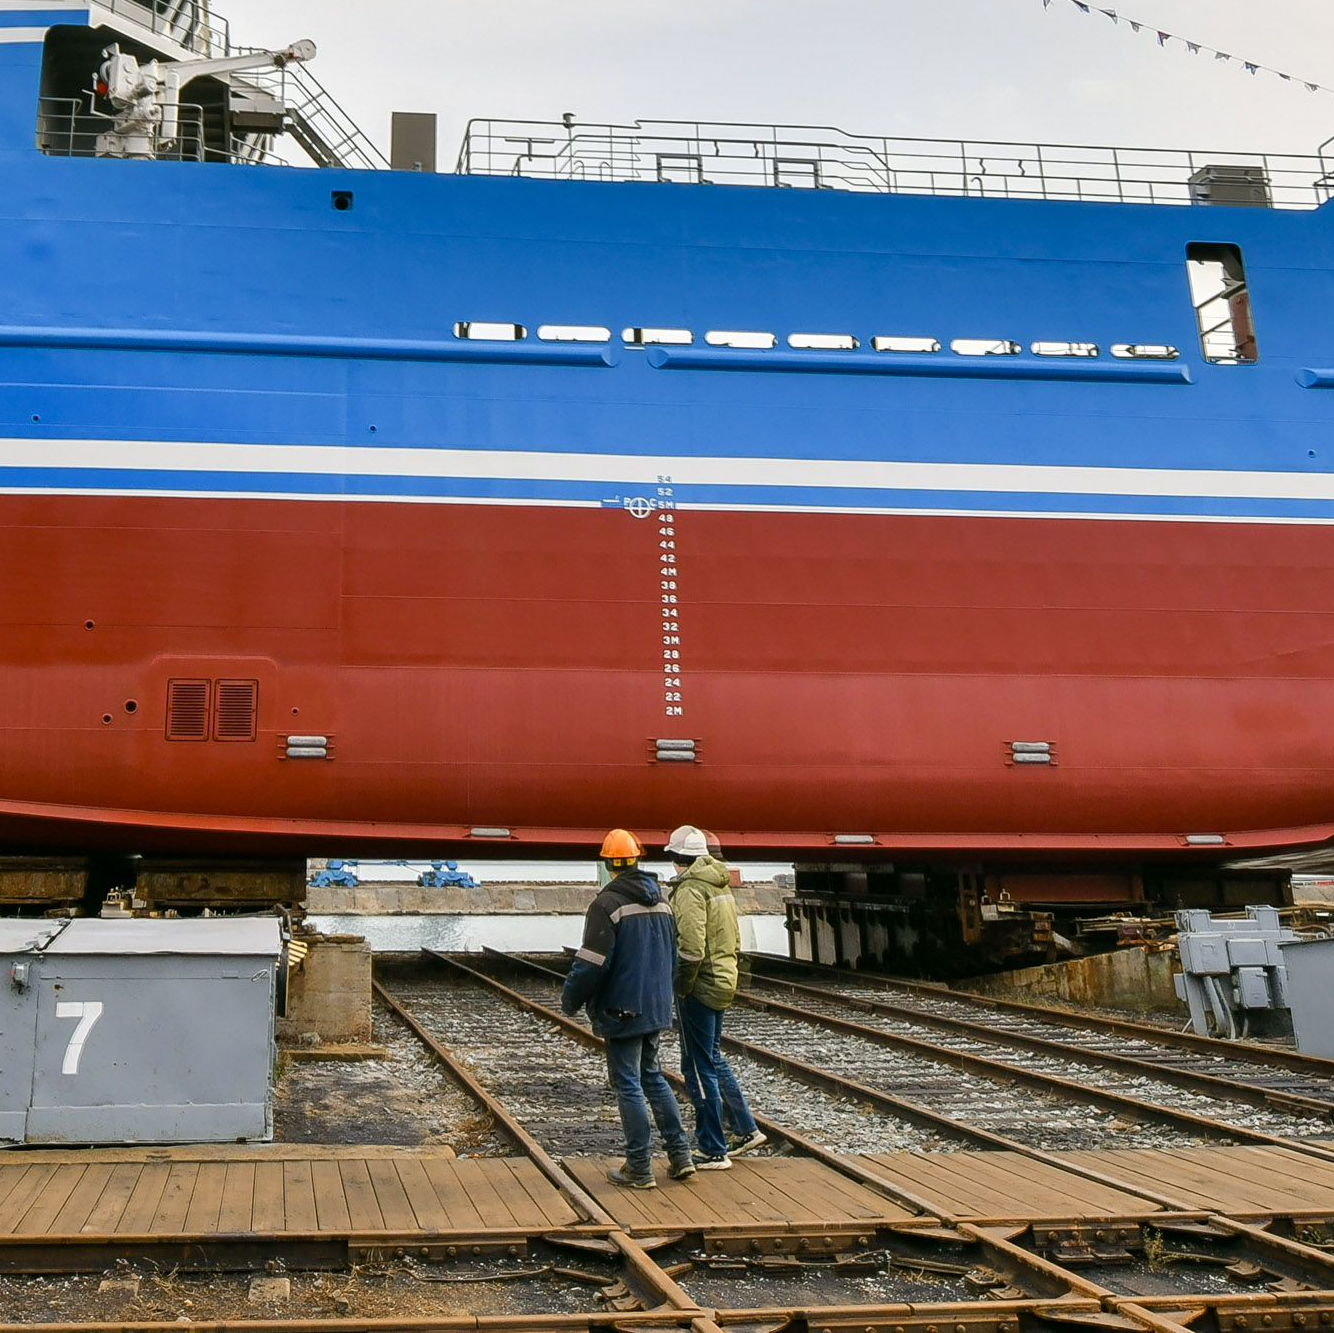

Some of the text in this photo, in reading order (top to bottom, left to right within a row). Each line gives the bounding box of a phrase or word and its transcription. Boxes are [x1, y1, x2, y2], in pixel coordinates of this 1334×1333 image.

[657, 487, 673, 496] 52
[658, 500, 674, 510] 5M
[658, 514, 674, 523] 48
[658, 527, 675, 536] 46
[659, 540, 675, 549] 44
[659, 554, 676, 563] 42
[660, 567, 678, 577] 4M
[660, 581, 677, 590] 38
[661, 594, 678, 603] 36
[662, 608, 678, 617] 34
[662, 622, 679, 631] 32
[663, 636, 680, 645] 3M
[663, 649, 680, 659] 28
[664, 664, 680, 673] 26
[664, 678, 681, 687] 24
[665, 692, 682, 702] 22
[665, 706, 683, 716] 2M
[56, 1002, 103, 1074] 7
